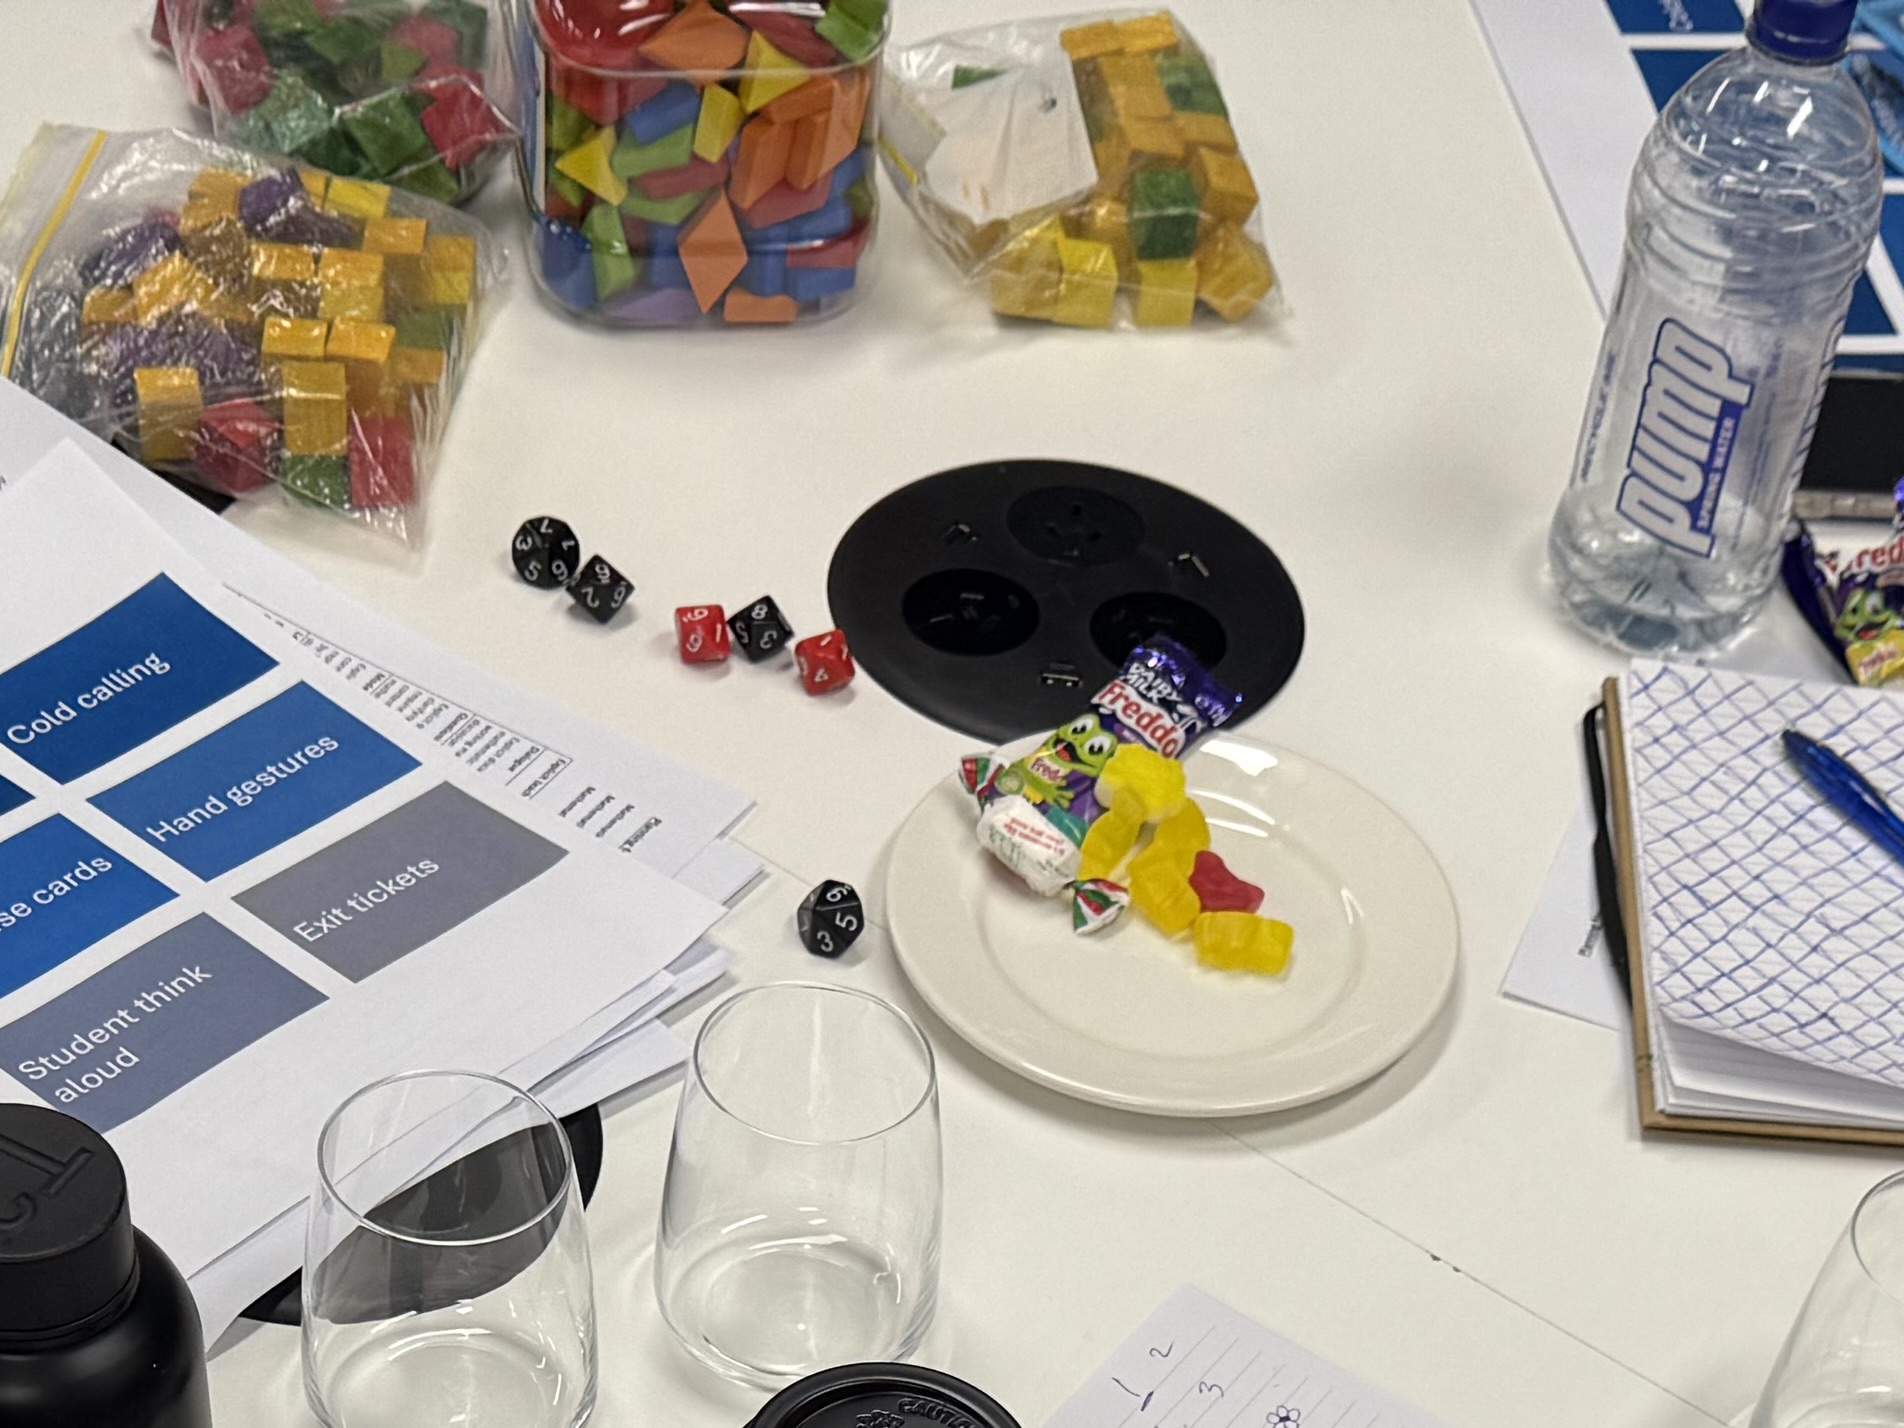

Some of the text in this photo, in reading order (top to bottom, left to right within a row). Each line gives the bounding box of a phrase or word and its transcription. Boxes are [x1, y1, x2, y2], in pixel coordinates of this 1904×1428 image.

[5, 651, 171, 748] Cold calling
[1098, 682, 1180, 759] Freddo
[146, 733, 340, 845] Hand gestures
[30, 855, 113, 920] cards
[294, 853, 441, 947] Exit tickets
[18, 962, 213, 1083] Student think
[54, 1047, 141, 1106] aloud
